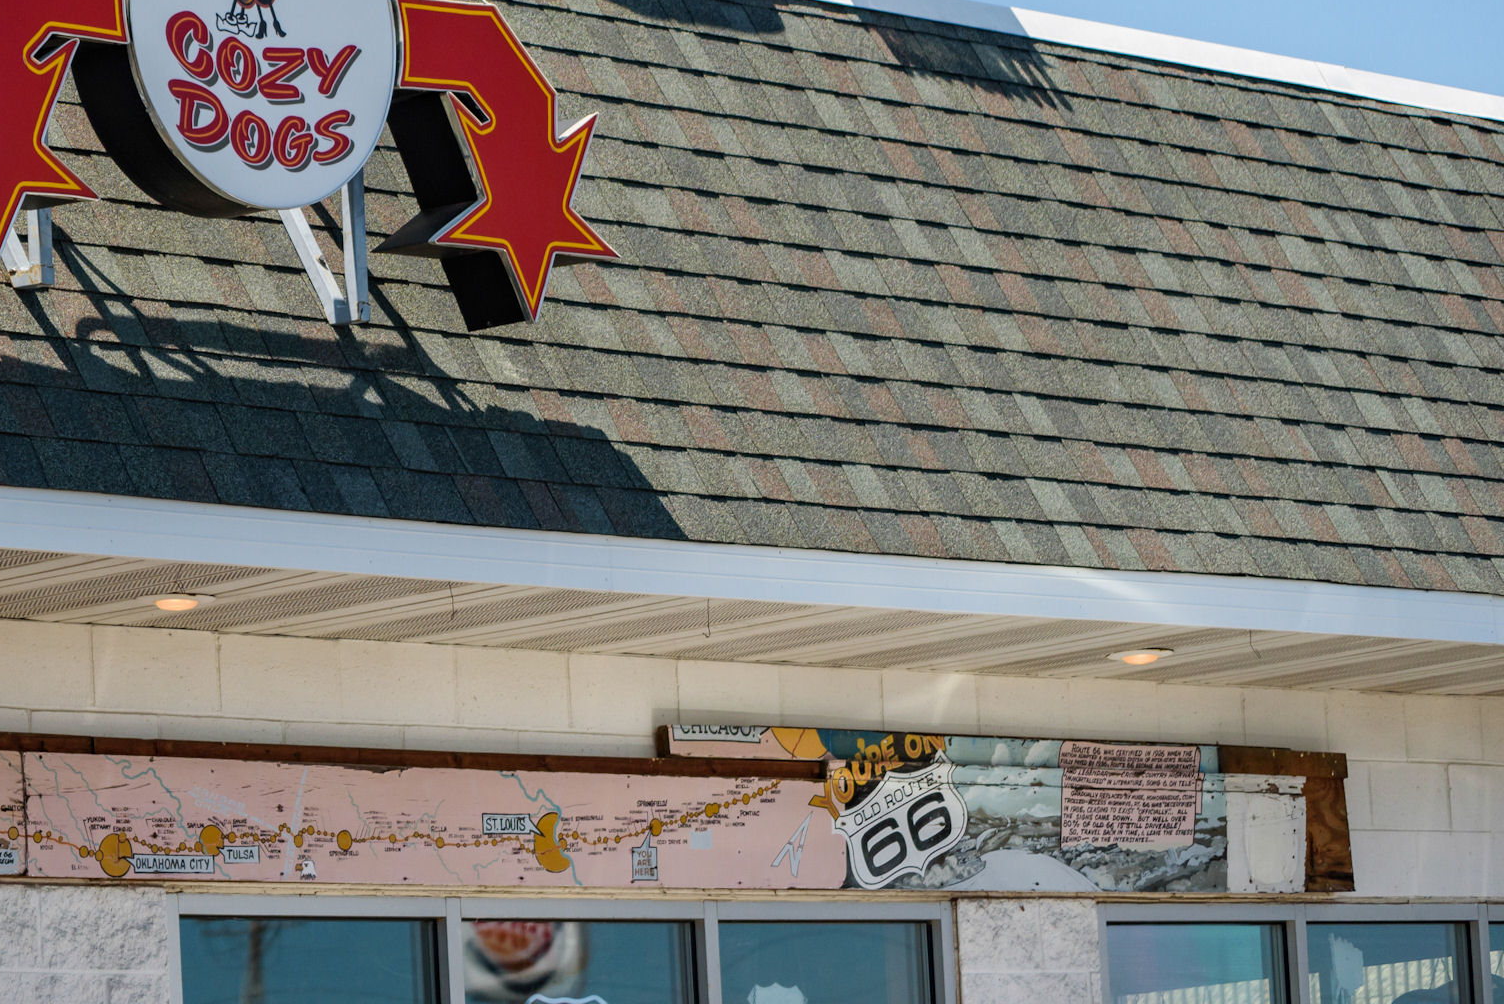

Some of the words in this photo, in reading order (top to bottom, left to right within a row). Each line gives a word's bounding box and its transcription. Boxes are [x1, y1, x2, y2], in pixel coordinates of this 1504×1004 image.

[165, 10, 361, 104] COZY
[168, 79, 355, 171] DOGS
[679, 724, 755, 738] CHICAGO!
[1072, 743, 1090, 754] ROUTE
[1093, 747, 1101, 755] 66
[1116, 749, 1143, 757] CERTIFIED
[1152, 750, 1165, 758] 1926
[808, 734, 904, 821] YOU'RE
[904, 733, 947, 760] ON
[1113, 779, 1144, 787] LITERATURE,
[853, 800, 882, 827] OLD
[884, 772, 937, 810] ROUTE
[485, 817, 498, 831] ST.
[501, 817, 526, 831] LOUIS
[1063, 820, 1080, 828] 80%
[1144, 822, 1183, 830] DRIVEABLE!
[860, 791, 953, 878] 66
[1069, 828, 1079, 836] SO,
[1124, 829, 1140, 837] TIME,
[226, 849, 254, 861] TULSA
[637, 850, 653, 859] YOU
[136, 857, 186, 870] OKLAHOMA
[189, 857, 210, 870] CITY
[636, 859, 652, 867] ARE
[635, 867, 655, 877] HERE
